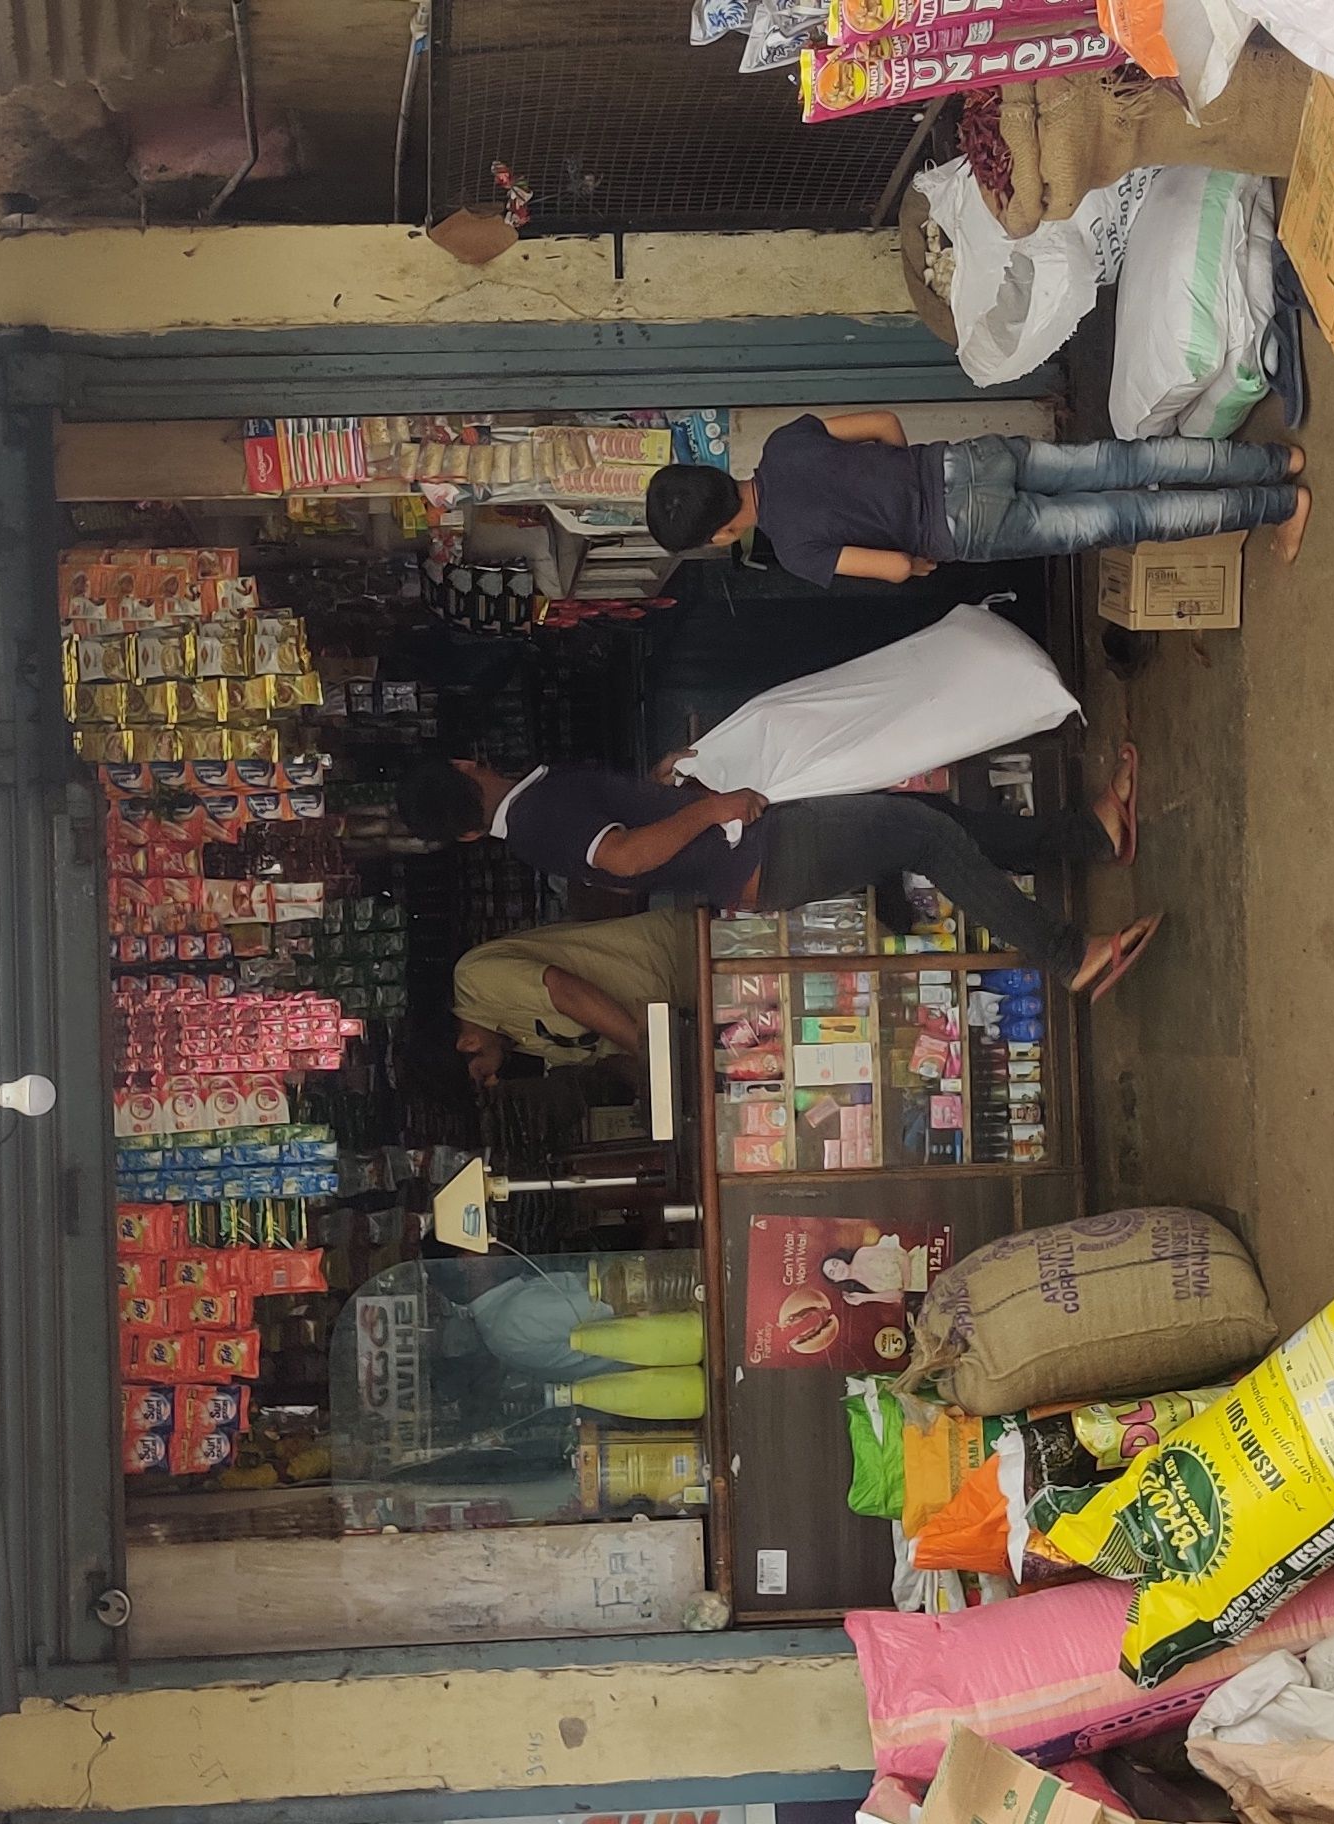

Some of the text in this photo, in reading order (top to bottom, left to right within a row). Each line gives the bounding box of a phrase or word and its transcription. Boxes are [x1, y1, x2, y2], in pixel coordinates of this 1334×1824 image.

[912, 32, 1110, 89] UNIQUE
[868, 64, 879, 98] NANDI
[929, 1237, 945, 1272] 12.5g
[1037, 1239, 1058, 1279] STATE
[782, 1257, 795, 1285] Can't
[796, 1256, 807, 1284] Won't
[1039, 1281, 1062, 1303] AP
[219, 1344, 234, 1365] Tide
[754, 1328, 765, 1352] Dark
[968, 1438, 980, 1468] BABA
[1164, 1455, 1178, 1478] LTD.
[1237, 1429, 1287, 1491] KESARI
[1184, 1499, 1215, 1537] FOODS
[1212, 1594, 1251, 1634] ANAND
[1247, 1565, 1285, 1599] BHOG
[1228, 1609, 1253, 1633] FOODS
